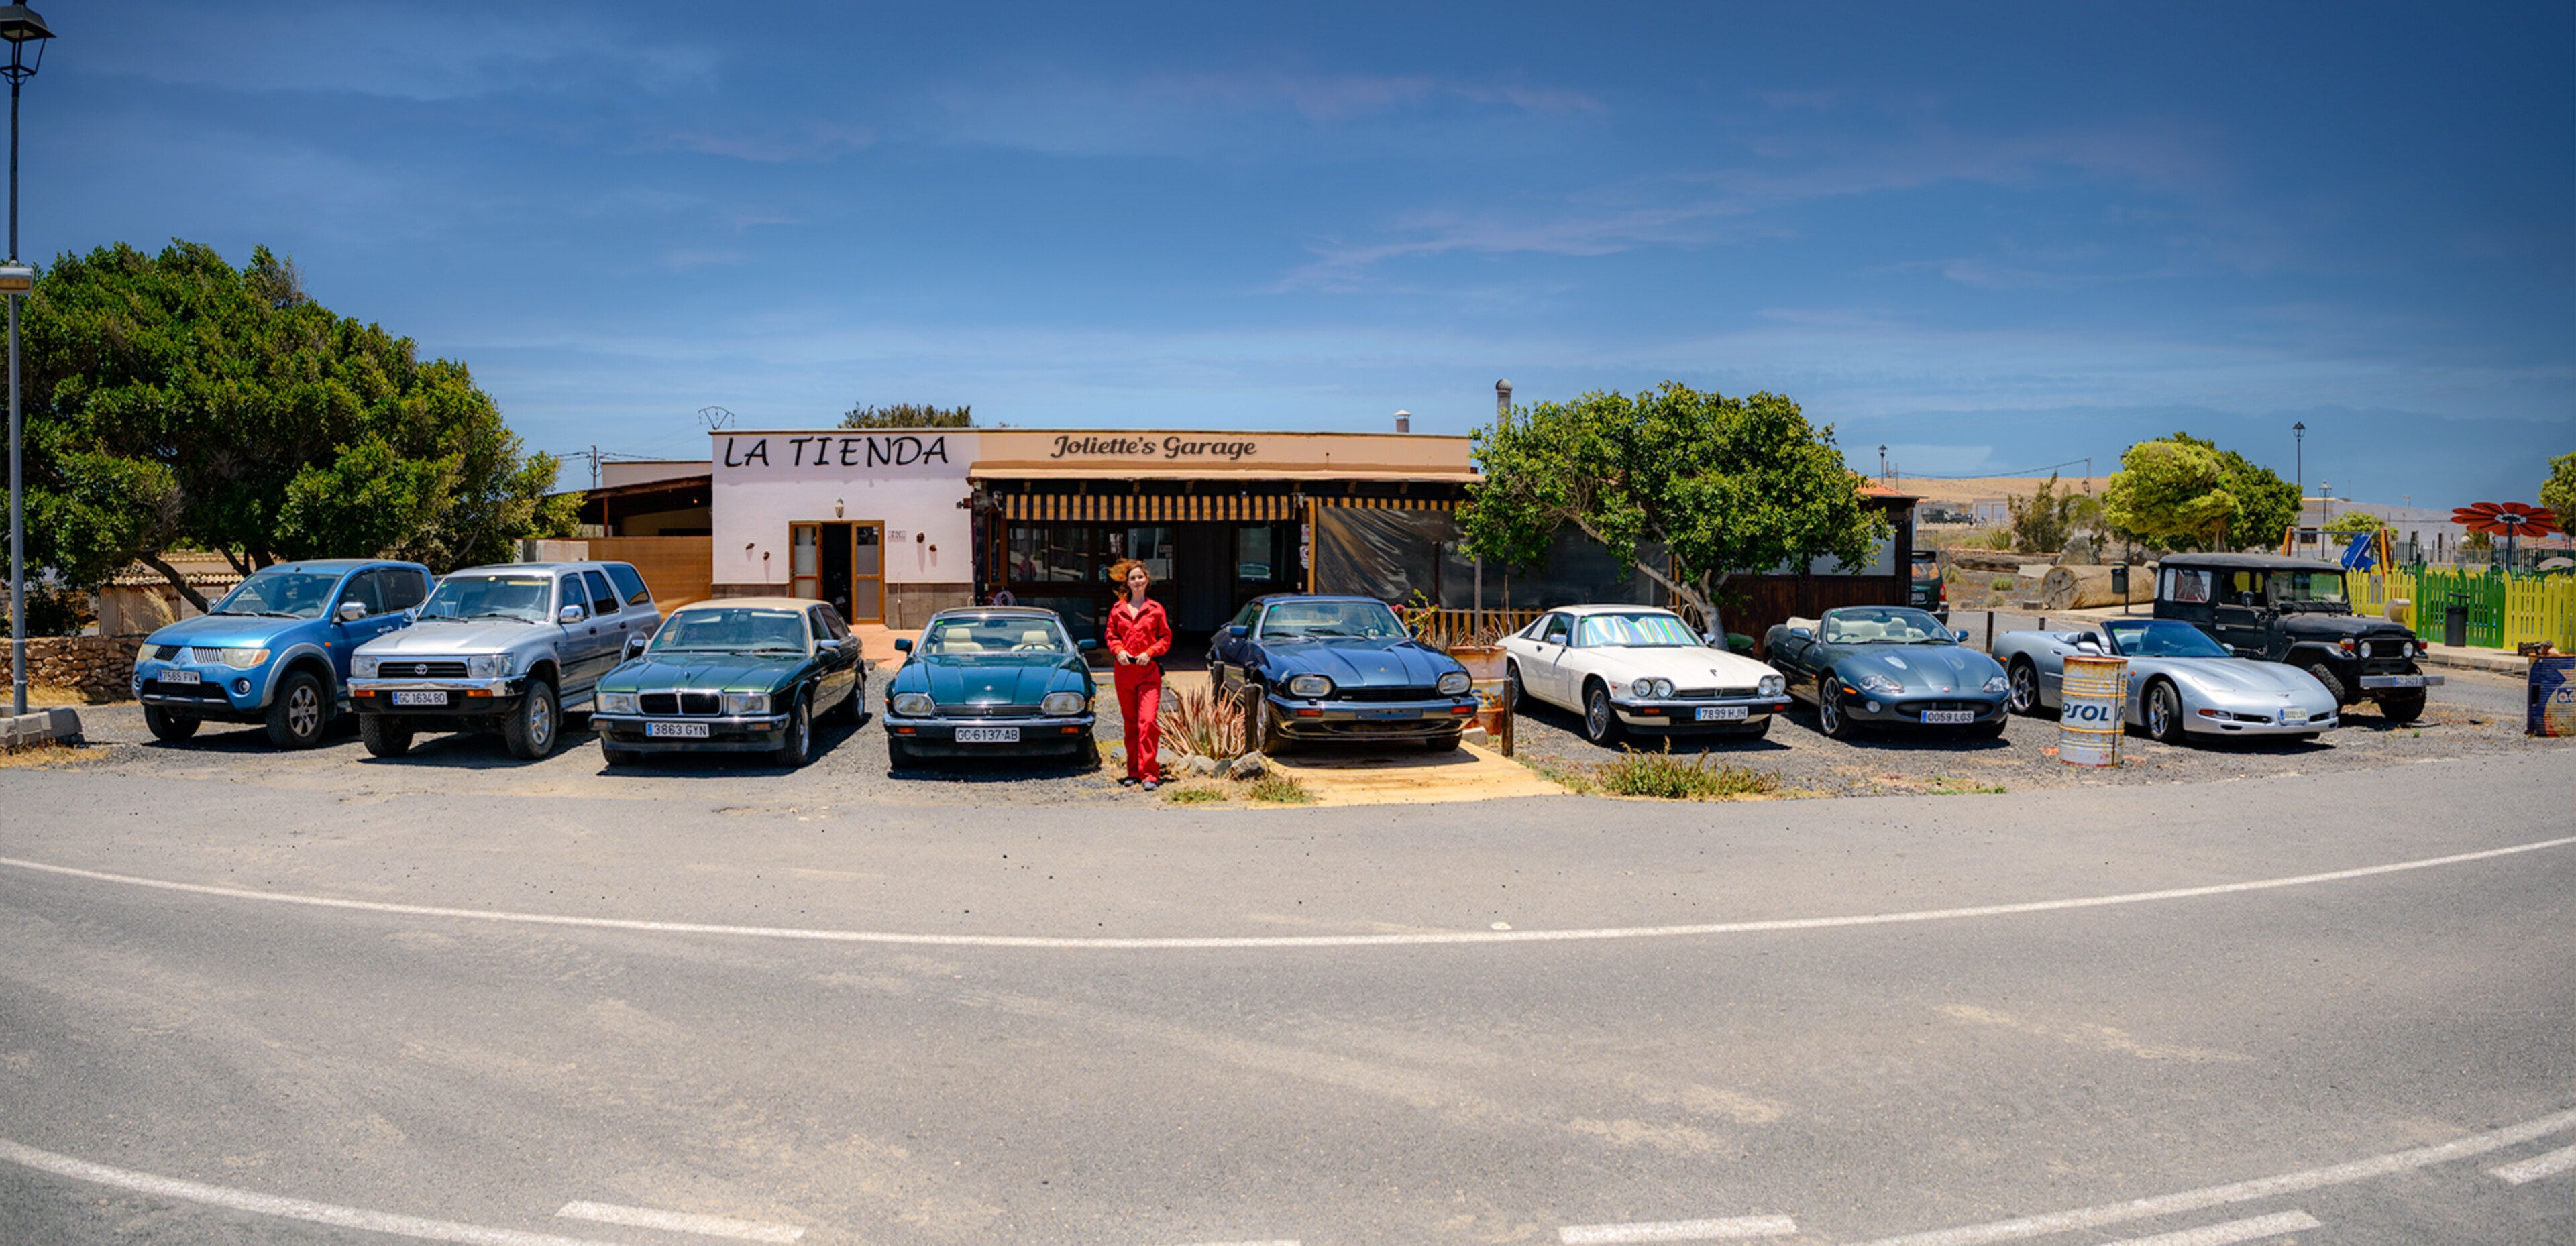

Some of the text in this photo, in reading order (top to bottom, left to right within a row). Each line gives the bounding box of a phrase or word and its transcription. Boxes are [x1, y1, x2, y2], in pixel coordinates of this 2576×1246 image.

[724, 436, 949, 467] LA TIENDA
[1050, 435, 1256, 461] Joliette's Garage
[1927, 712, 1952, 722] 0059
[655, 724, 706, 736] 3863 GYN
